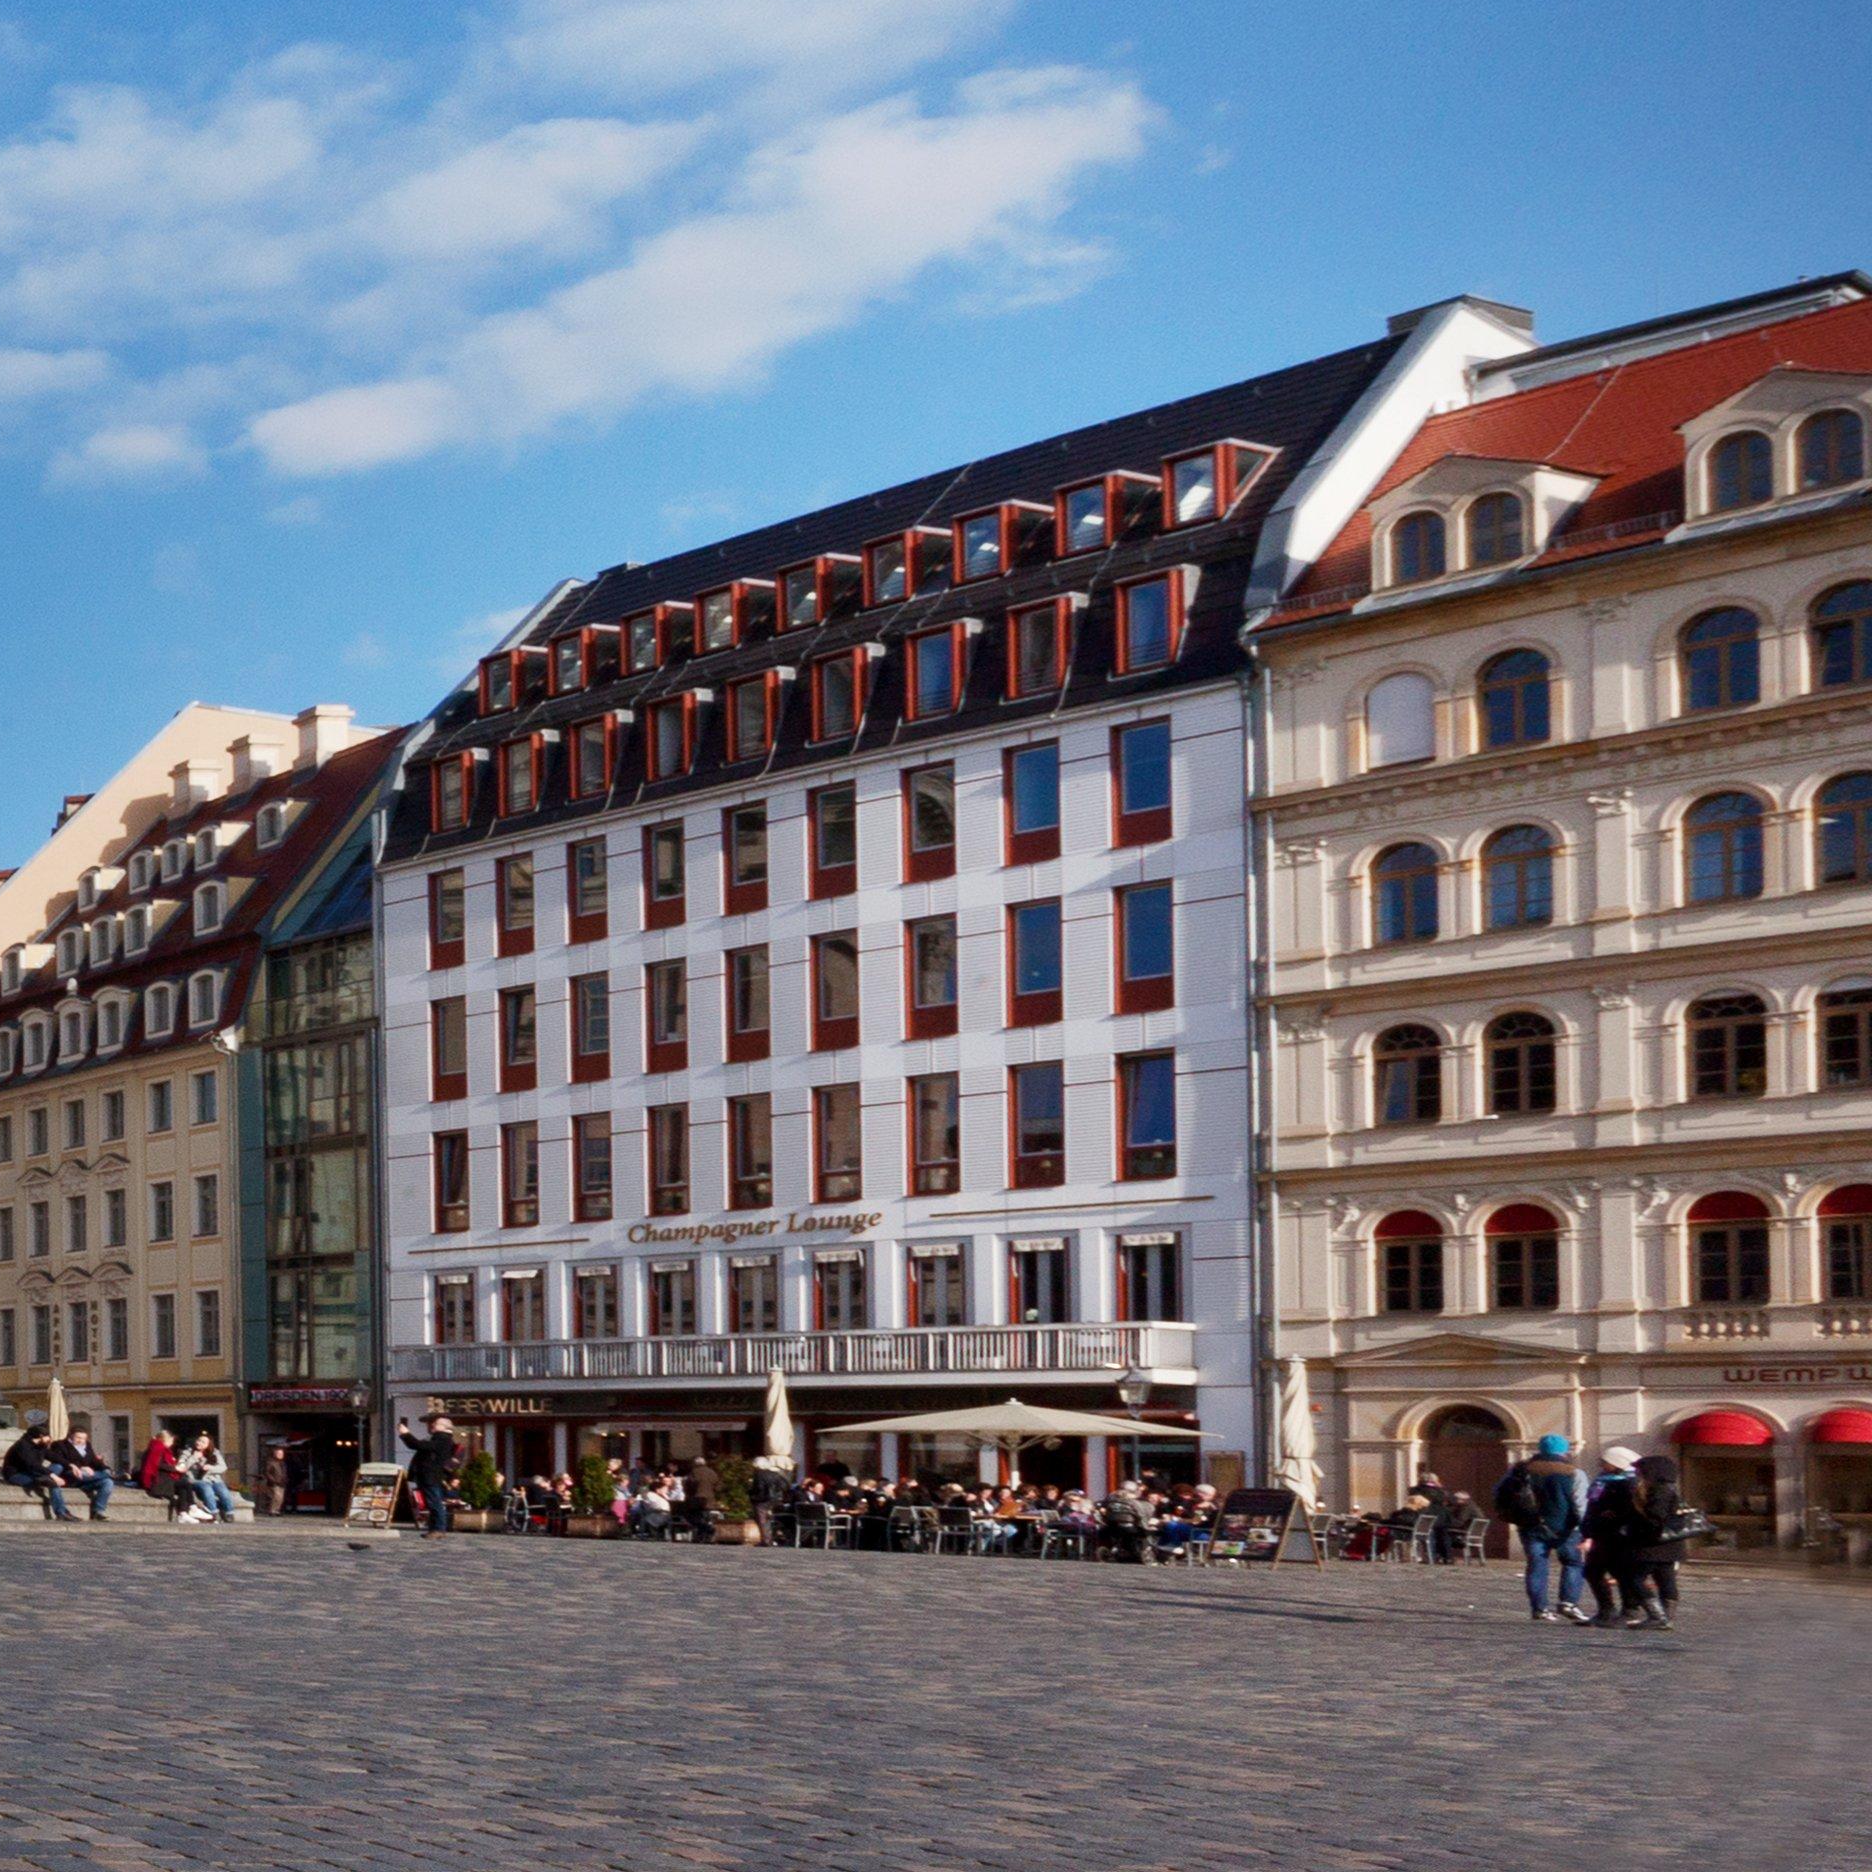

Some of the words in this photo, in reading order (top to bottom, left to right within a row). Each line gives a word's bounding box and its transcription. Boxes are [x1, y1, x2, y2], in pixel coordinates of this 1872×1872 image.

[627, 1219, 780, 1245] Champagner
[786, 1211, 883, 1235] Lounge
[52, 1303, 61, 1367] APART
[90, 1300, 99, 1366] HOTEL
